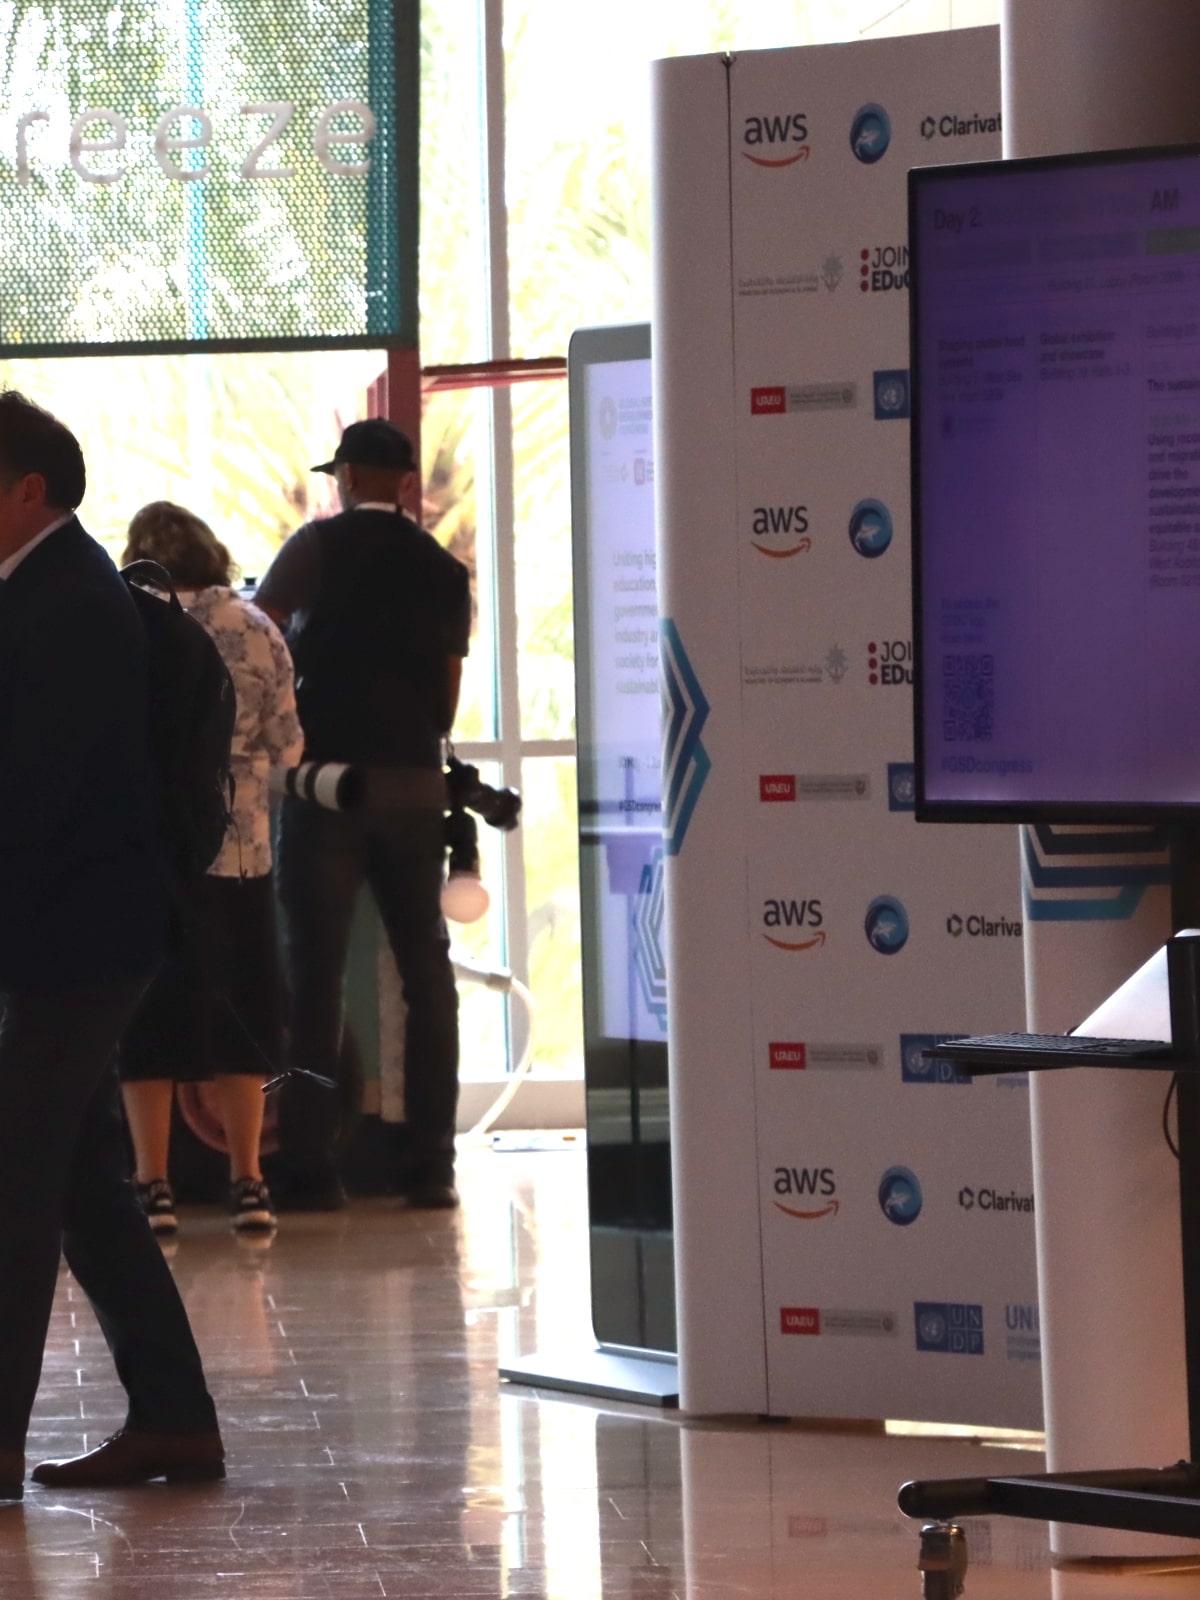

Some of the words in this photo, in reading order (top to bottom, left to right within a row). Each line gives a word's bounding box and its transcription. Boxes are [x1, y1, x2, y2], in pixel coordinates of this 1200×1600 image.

[744, 113, 808, 144] aws
[939, 112, 1002, 137] Clarivat
[934, 208, 965, 234] Day
[753, 505, 809, 535] aws
[880, 641, 912, 662] JOI
[881, 664, 912, 685] EDu
[763, 900, 823, 927] aws
[967, 914, 1023, 937] Clariva
[774, 1167, 836, 1196] aws
[978, 1188, 1034, 1213] Clarivat
[1005, 1304, 1039, 1330] UN
